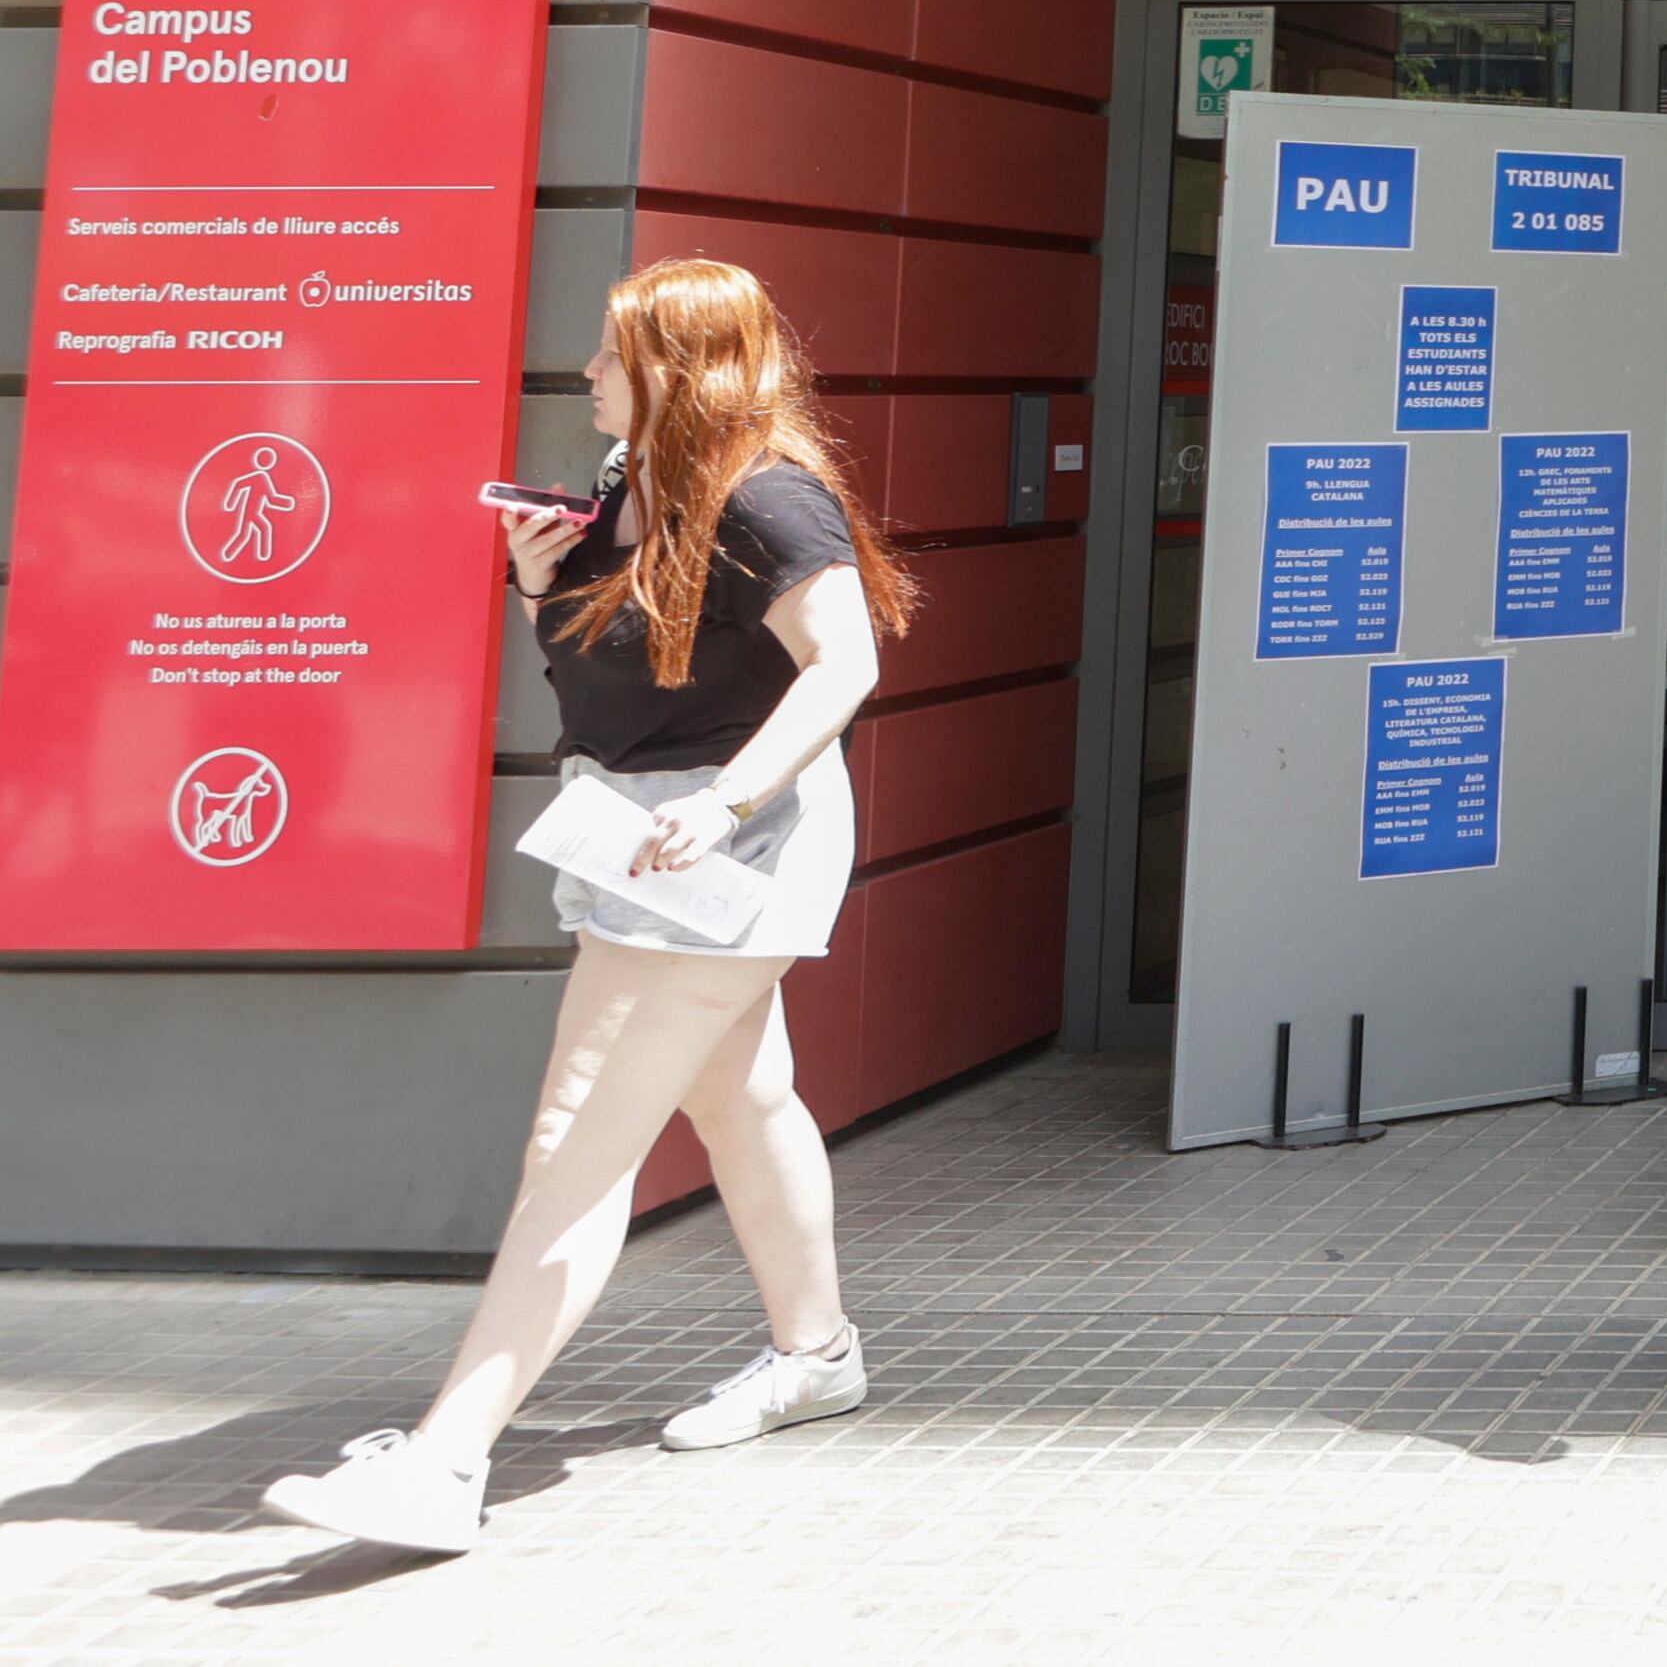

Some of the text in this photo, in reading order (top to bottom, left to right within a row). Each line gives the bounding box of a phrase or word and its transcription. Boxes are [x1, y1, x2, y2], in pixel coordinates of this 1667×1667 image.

[95, 2, 252, 43] Campus
[89, 50, 348, 83] del Poblenou
[1504, 169, 1615, 191] TRIBUNAL
[1295, 177, 1390, 214] PAU
[68, 217, 400, 235] Serveis comercials de lliure accés
[1511, 211, 1605, 232] 2 01 085
[61, 280, 472, 303] Cafeteria/Restaurant universitas
[1410, 316, 1487, 327] A LES 8.30 h
[56, 331, 283, 352] Reprografia RICOH
[1419, 332, 1477, 343] TOTS ELS
[1407, 348, 1487, 359] ESTUDIANTS
[1404, 364, 1433, 376] HAN
[1406, 380, 1485, 391] A LES AULES
[1404, 396, 1485, 408] ASSIGNADES
[1536, 446, 1595, 458] PAU 2022
[1306, 458, 1371, 470] PAU 2022
[1324, 480, 1370, 489] LLENGUA
[1540, 477, 1552, 486] DE
[1553, 477, 1569, 486] LES
[1311, 492, 1364, 502] CATALANA
[155, 613, 347, 633] No us atureu a la porta
[128, 639, 369, 659] No os detengáis en la puerta
[150, 667, 342, 687] Don't stop at the door
[1406, 674, 1469, 687] PAU 2022
[1445, 693, 1491, 703] ECONOMIA
[1405, 708, 1417, 716] DE
[1385, 717, 1438, 728] LITERATURA
[1430, 724, 1484, 735] TECNOLOGIA
[1409, 737, 1462, 747] INDUSTRIAL
[1378, 757, 1431, 771] Distribució
[1433, 756, 1446, 766] de
